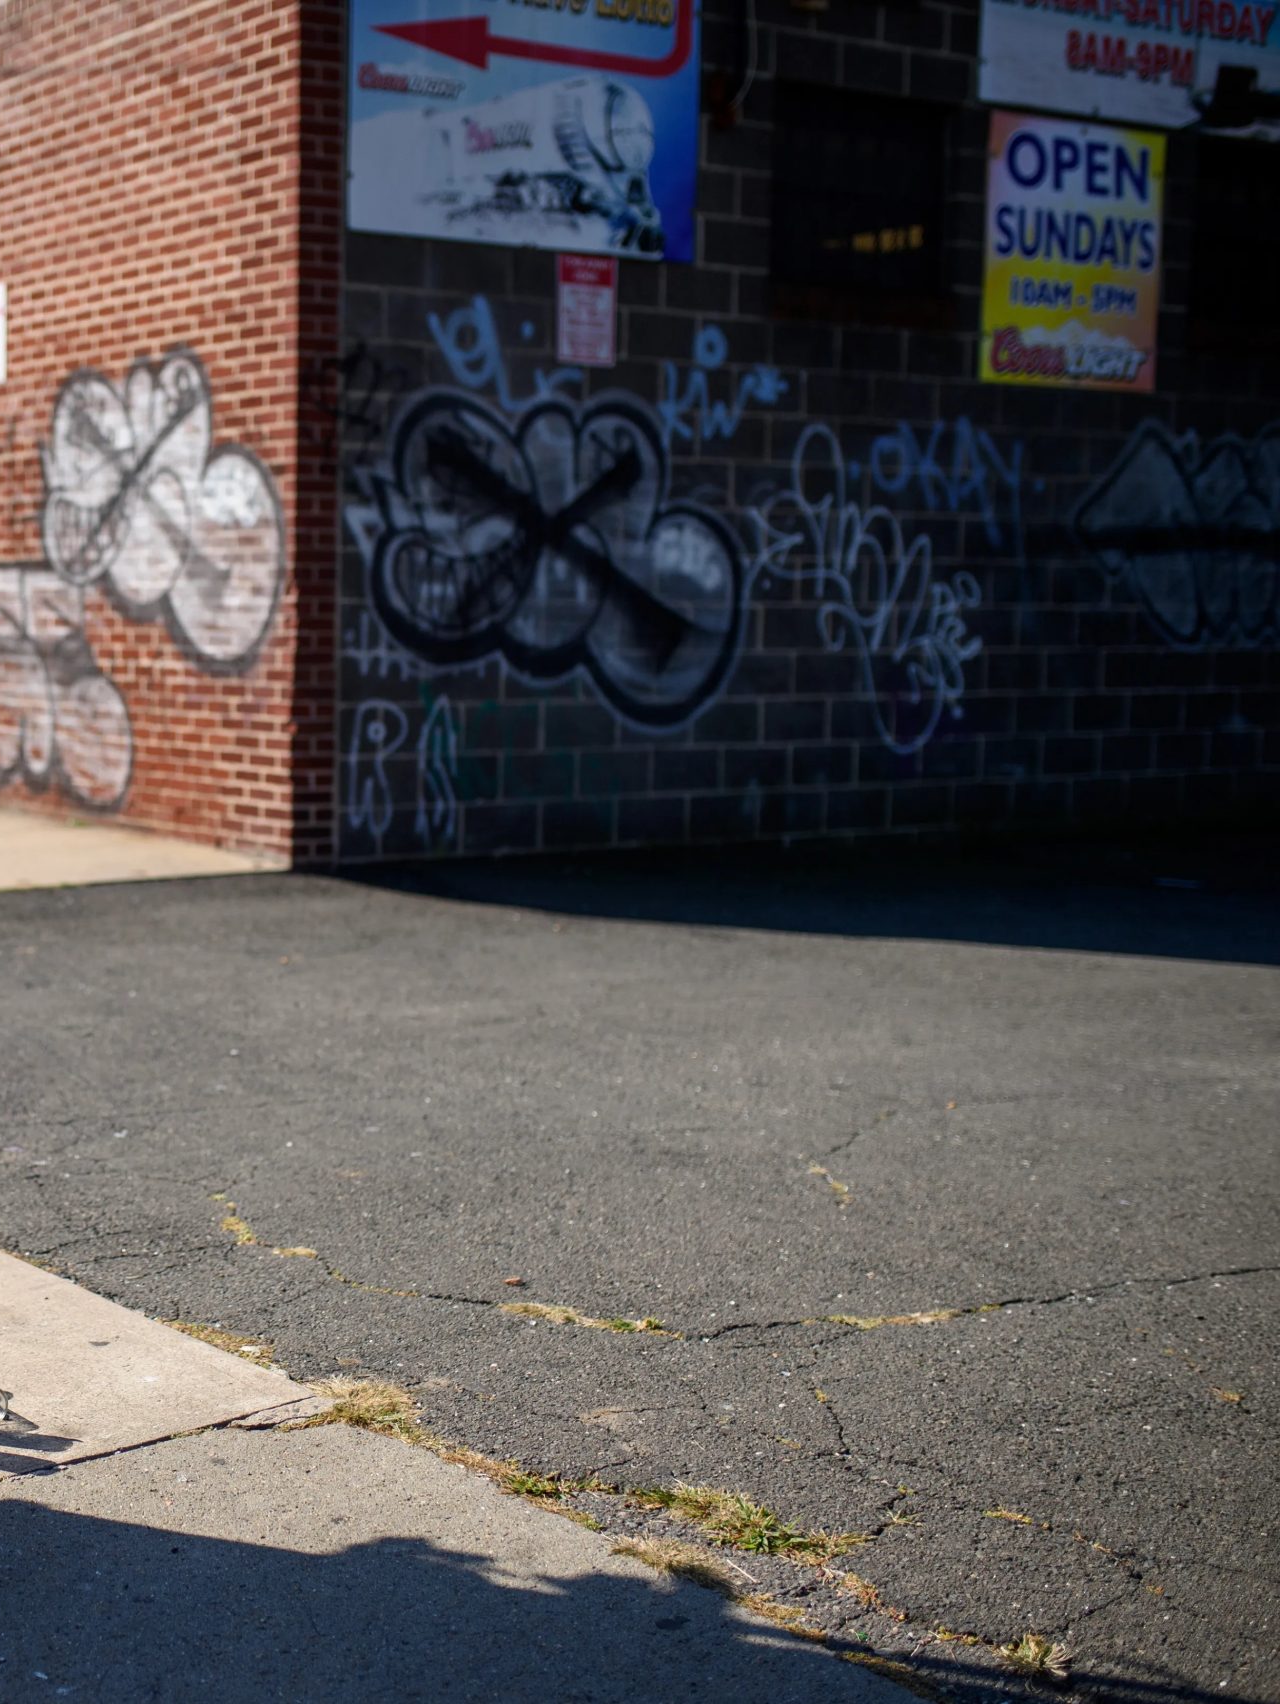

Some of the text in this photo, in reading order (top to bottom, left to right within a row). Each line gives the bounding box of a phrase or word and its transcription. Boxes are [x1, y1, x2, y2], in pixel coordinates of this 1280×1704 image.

[988, 0, 1274, 45] Y-SATURDAY
[1064, 29, 1195, 86] 8AM-9PM
[1008, 131, 1150, 200] OPEN
[996, 205, 1154, 270] SUNDAYS
[1011, 277, 1073, 308] 10AM
